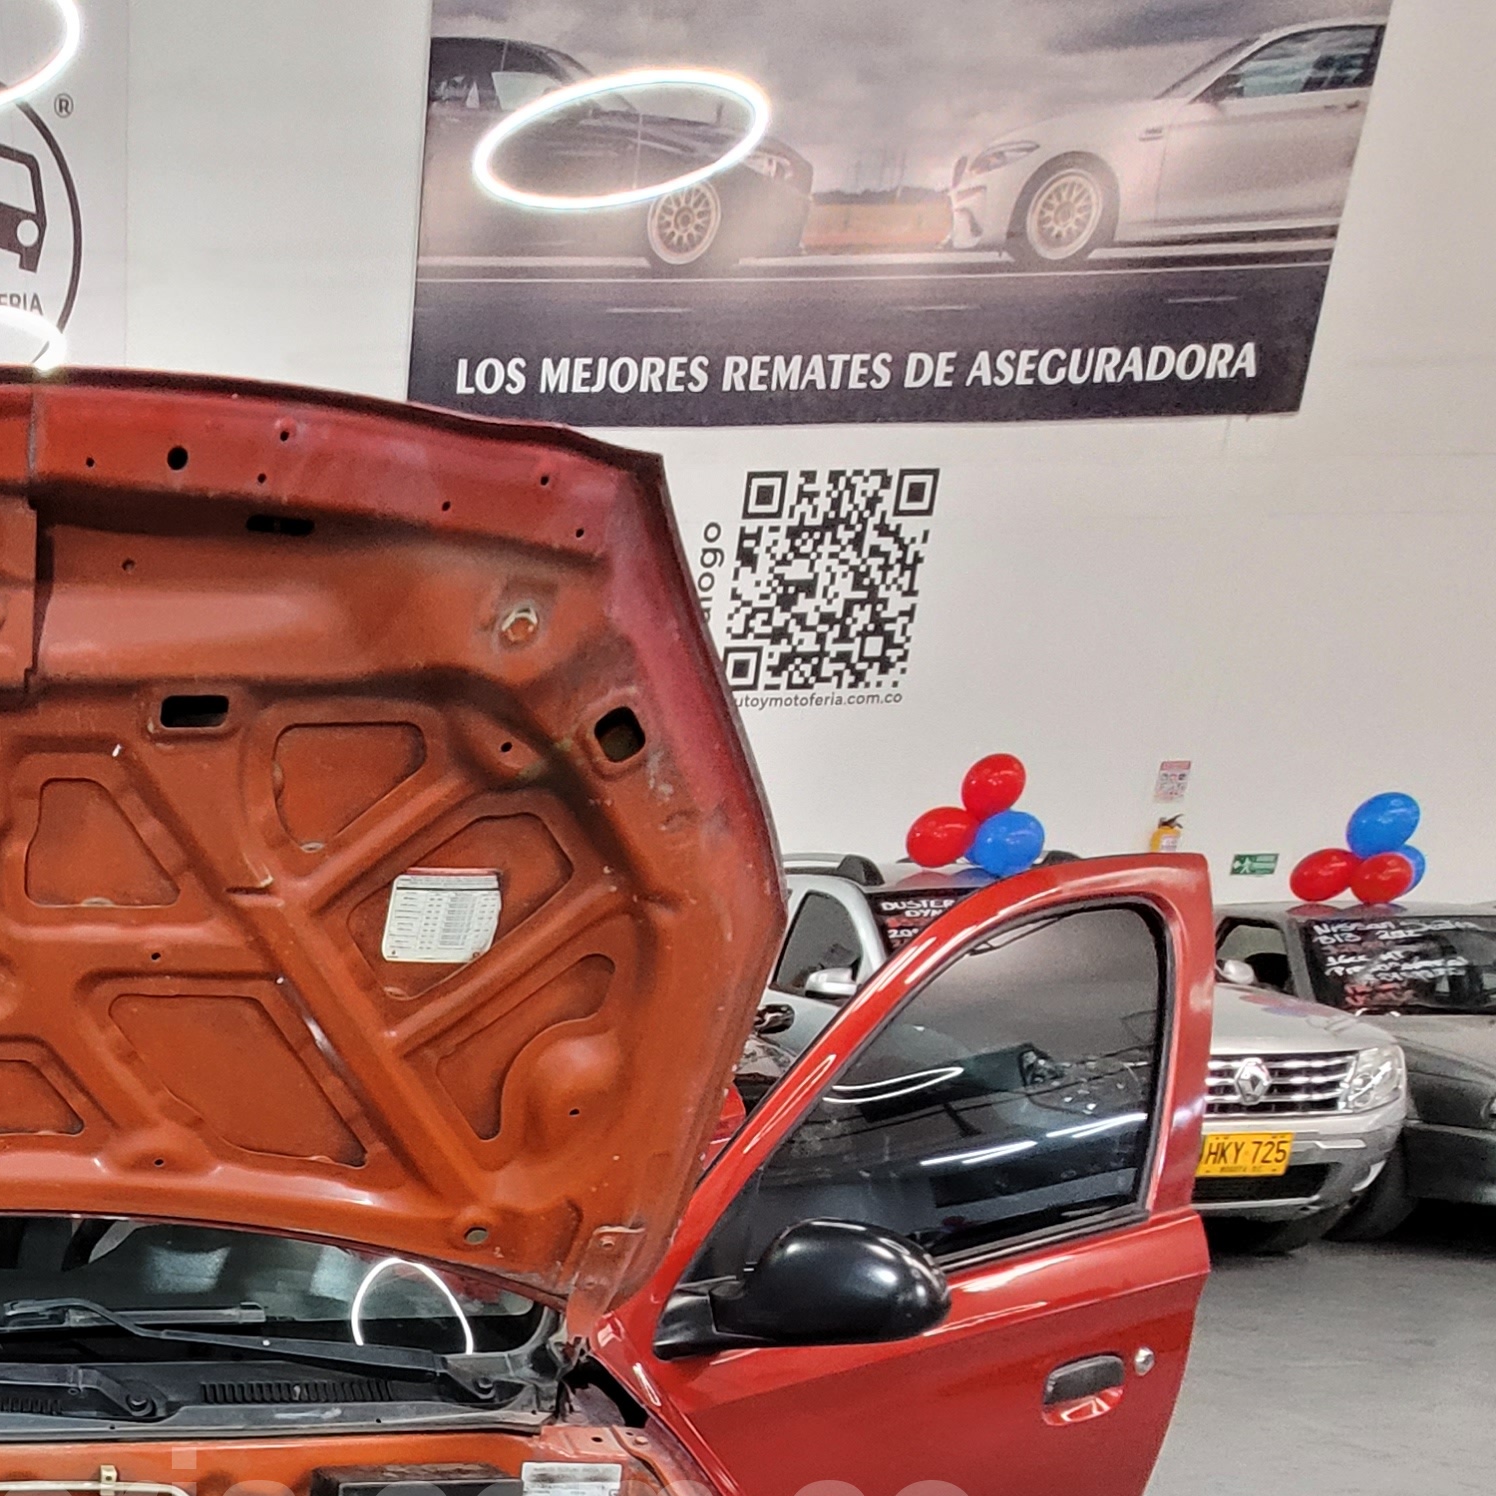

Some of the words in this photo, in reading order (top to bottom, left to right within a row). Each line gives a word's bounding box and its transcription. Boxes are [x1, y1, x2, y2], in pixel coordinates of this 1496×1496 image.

[455, 357, 526, 394] LOS
[538, 355, 710, 394] MEJORES
[721, 352, 892, 392] REMATES
[903, 349, 955, 388] DE
[966, 341, 1258, 387] ASEGURADORA
[733, 692, 903, 711] utoymotoferia.com.co
[1204, 1141, 1245, 1164] HKY
[1251, 1141, 1289, 1164] 725
